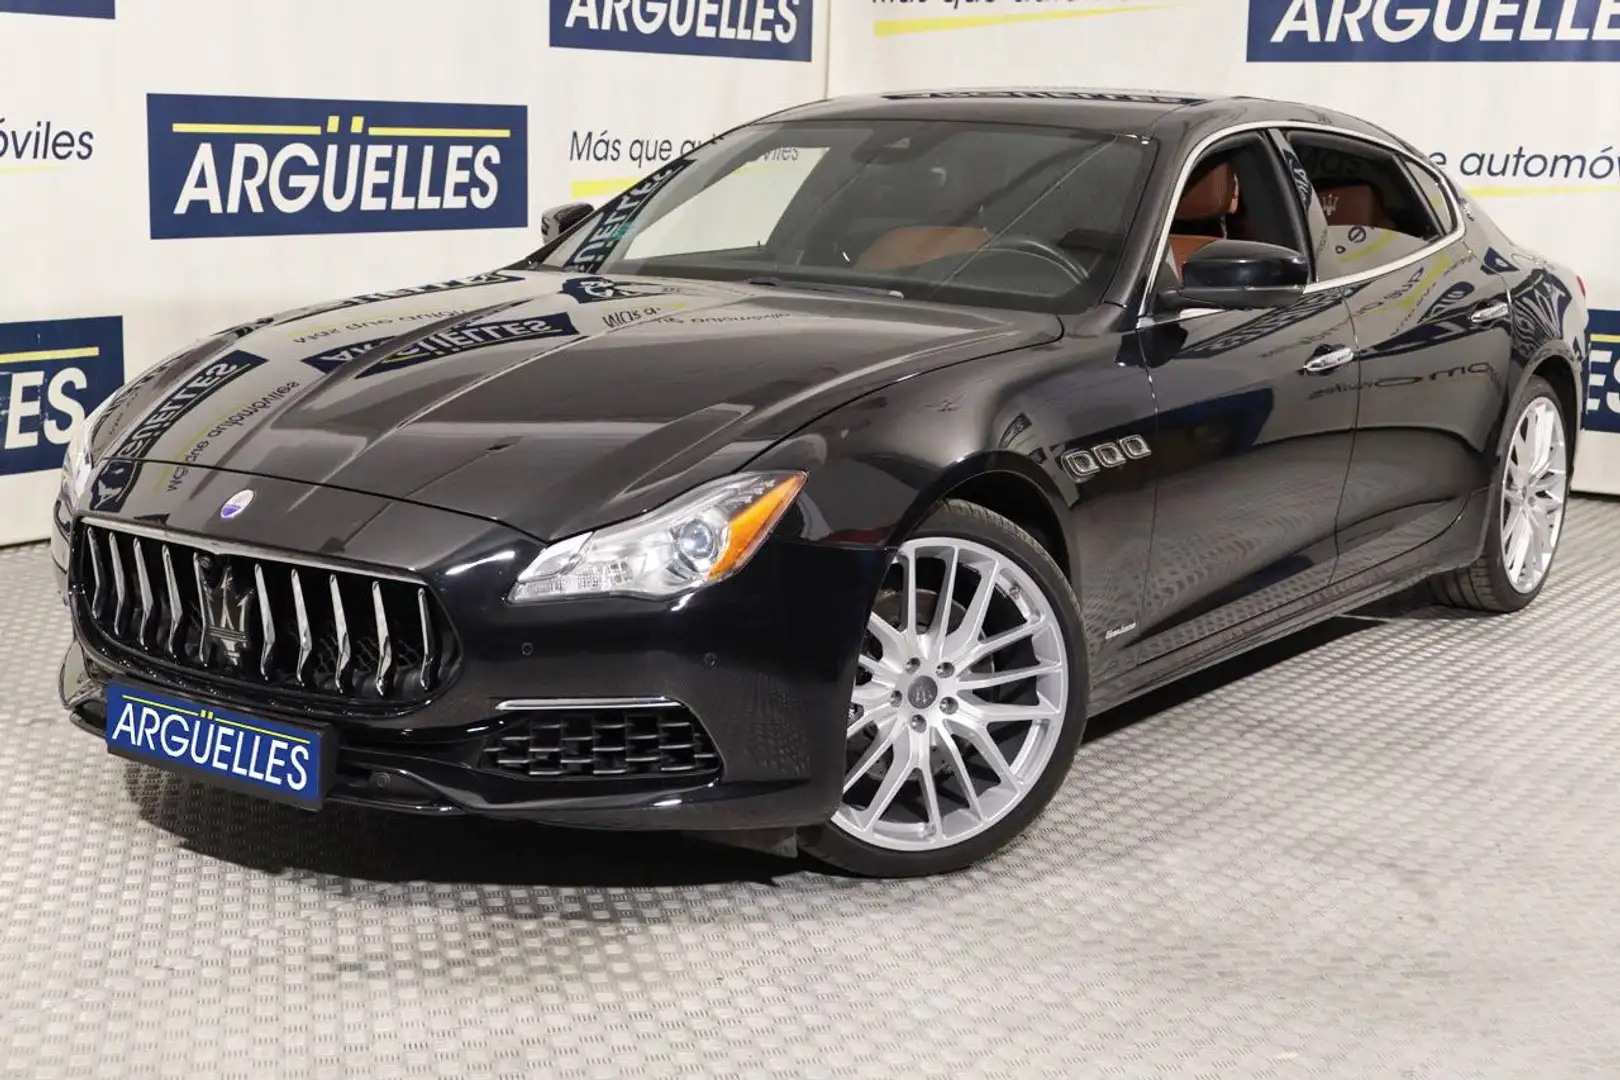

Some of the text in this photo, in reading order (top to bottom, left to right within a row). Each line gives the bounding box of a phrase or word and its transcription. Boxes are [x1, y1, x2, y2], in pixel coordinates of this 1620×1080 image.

[173, 115, 501, 216] ARGÜELLES
[570, 130, 621, 162] Más
[629, 139, 673, 168] que
[1460, 146, 1620, 179] automó
[112, 702, 310, 791] ARGÜELLES
